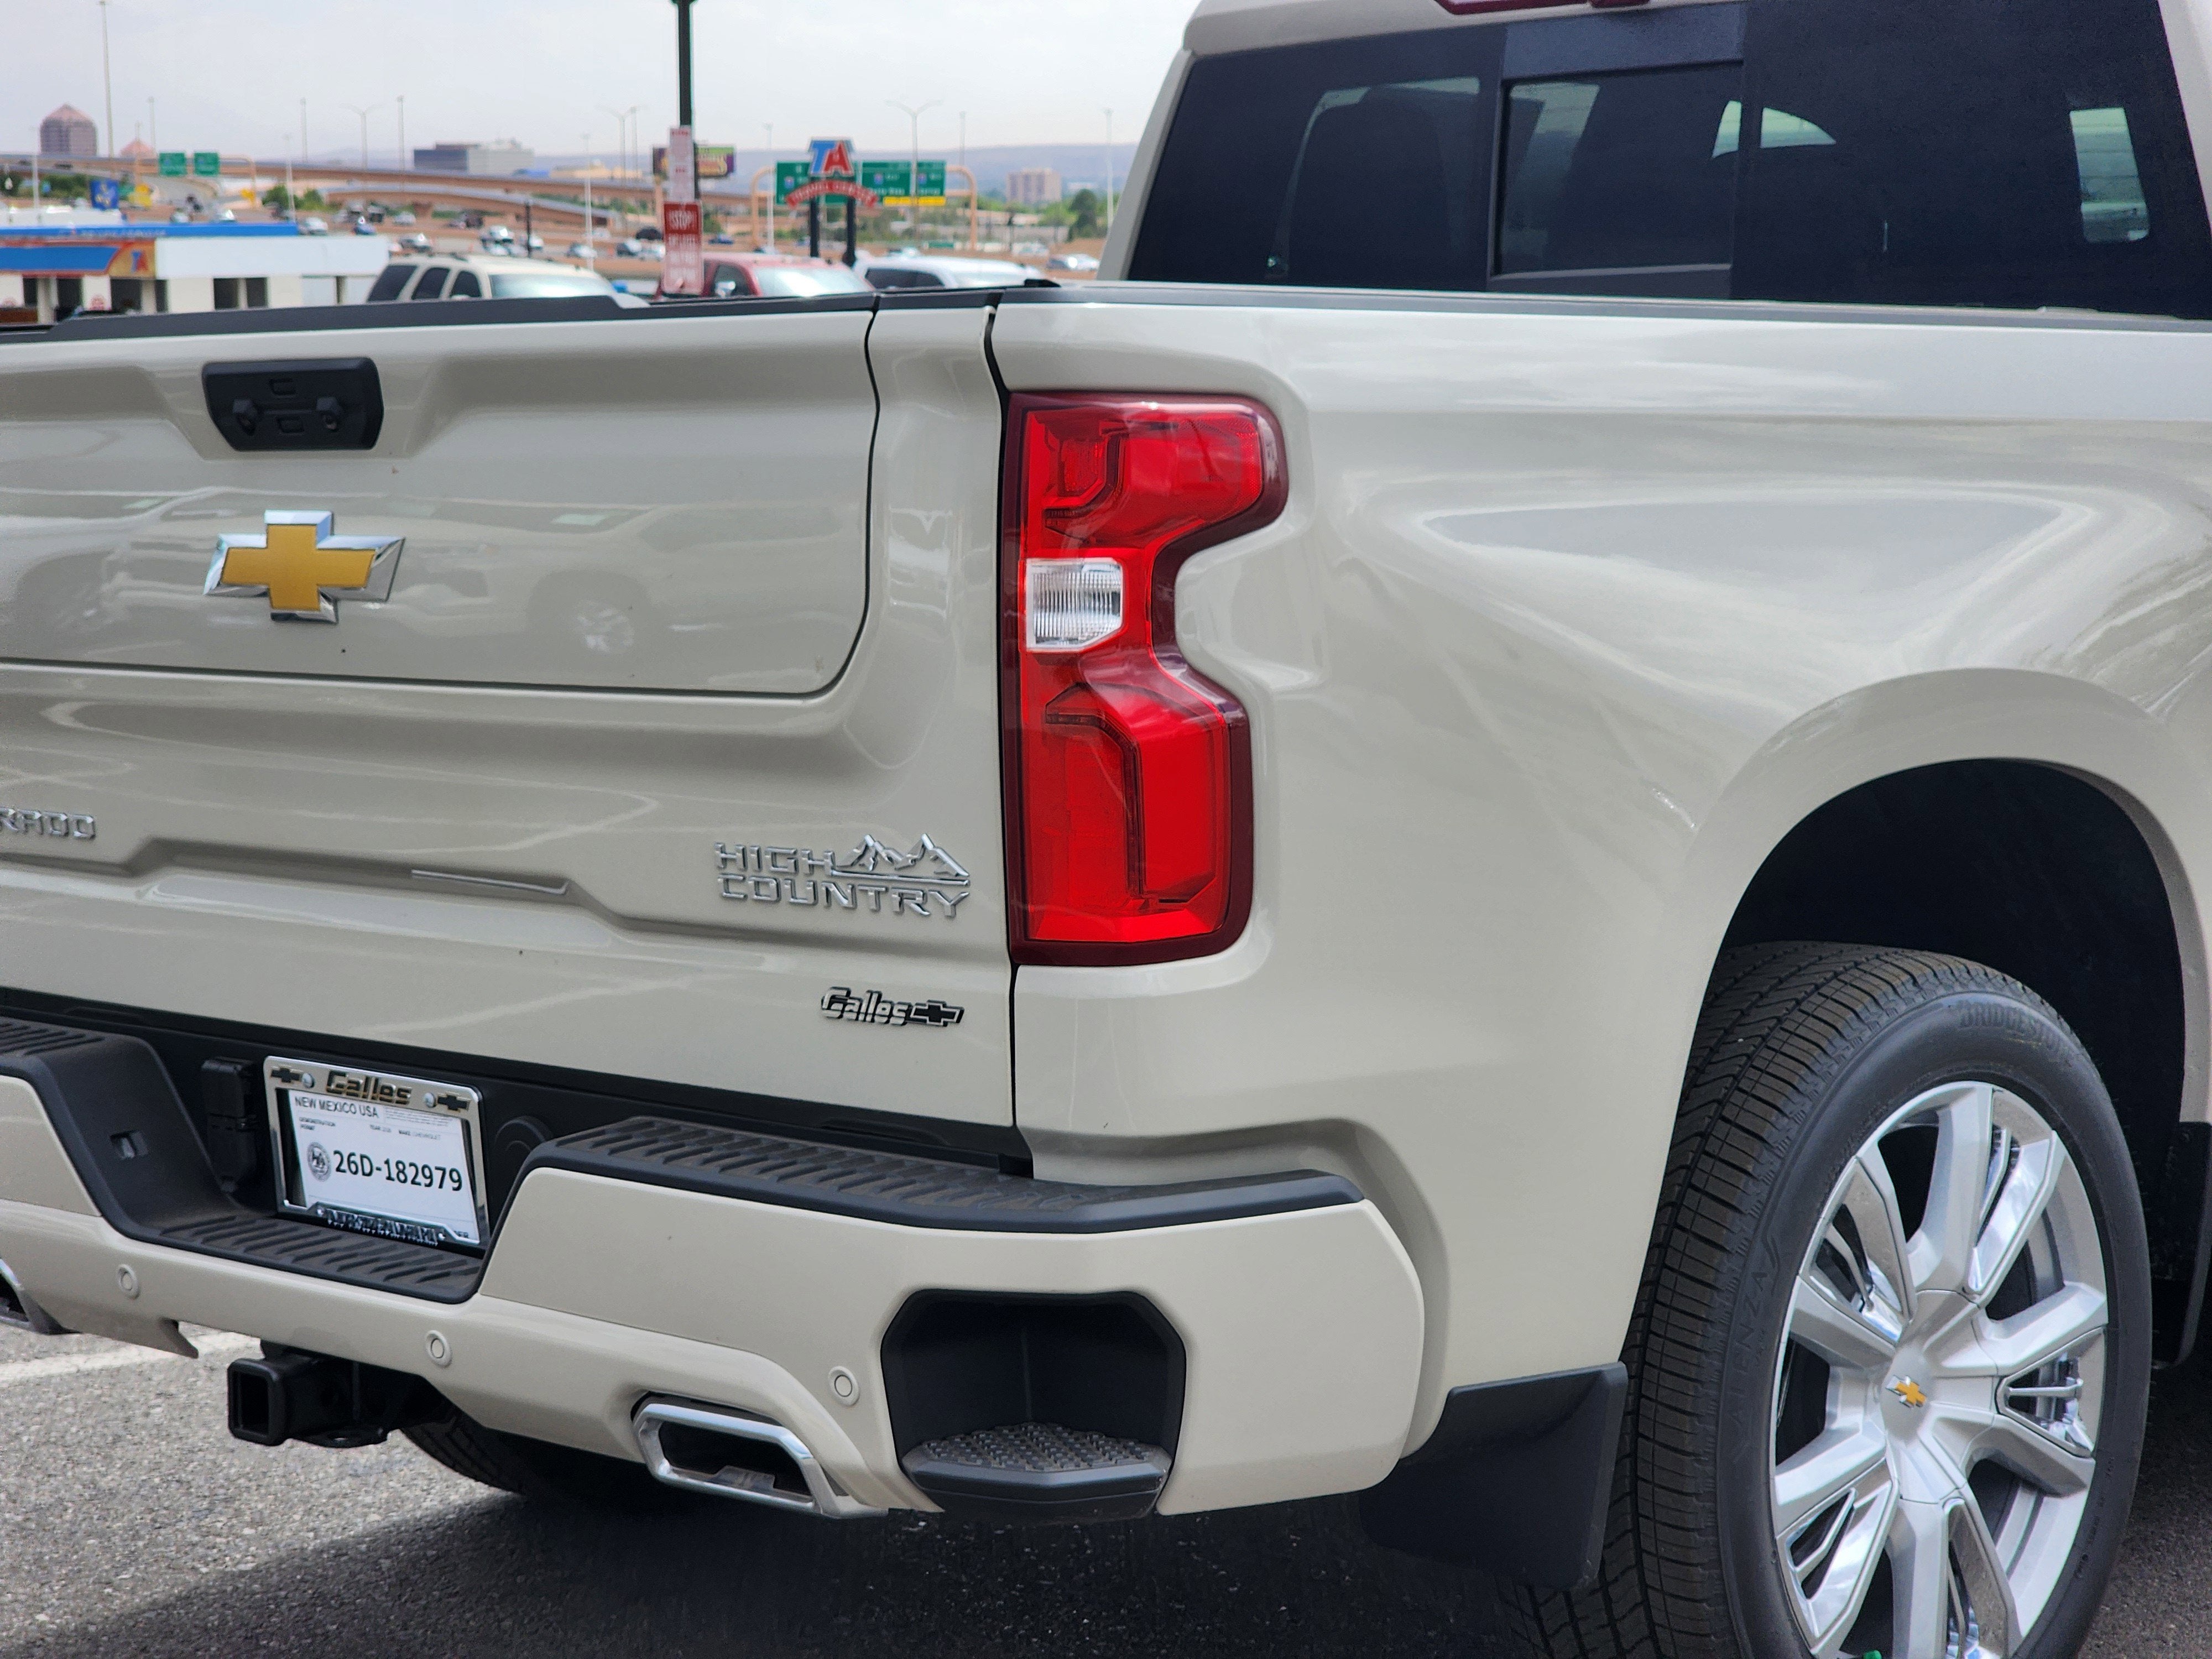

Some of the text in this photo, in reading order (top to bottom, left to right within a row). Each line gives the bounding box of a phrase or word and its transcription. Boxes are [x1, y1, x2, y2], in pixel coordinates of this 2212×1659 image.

[810, 139, 854, 177] TA
[713, 841, 837, 875] HIGH
[717, 872, 970, 918] COUNTRY
[294, 1096, 316, 1109] NEW
[319, 1099, 357, 1115] MEXICO
[358, 1104, 379, 1118] USA
[332, 1149, 463, 1192] 26D-182979
